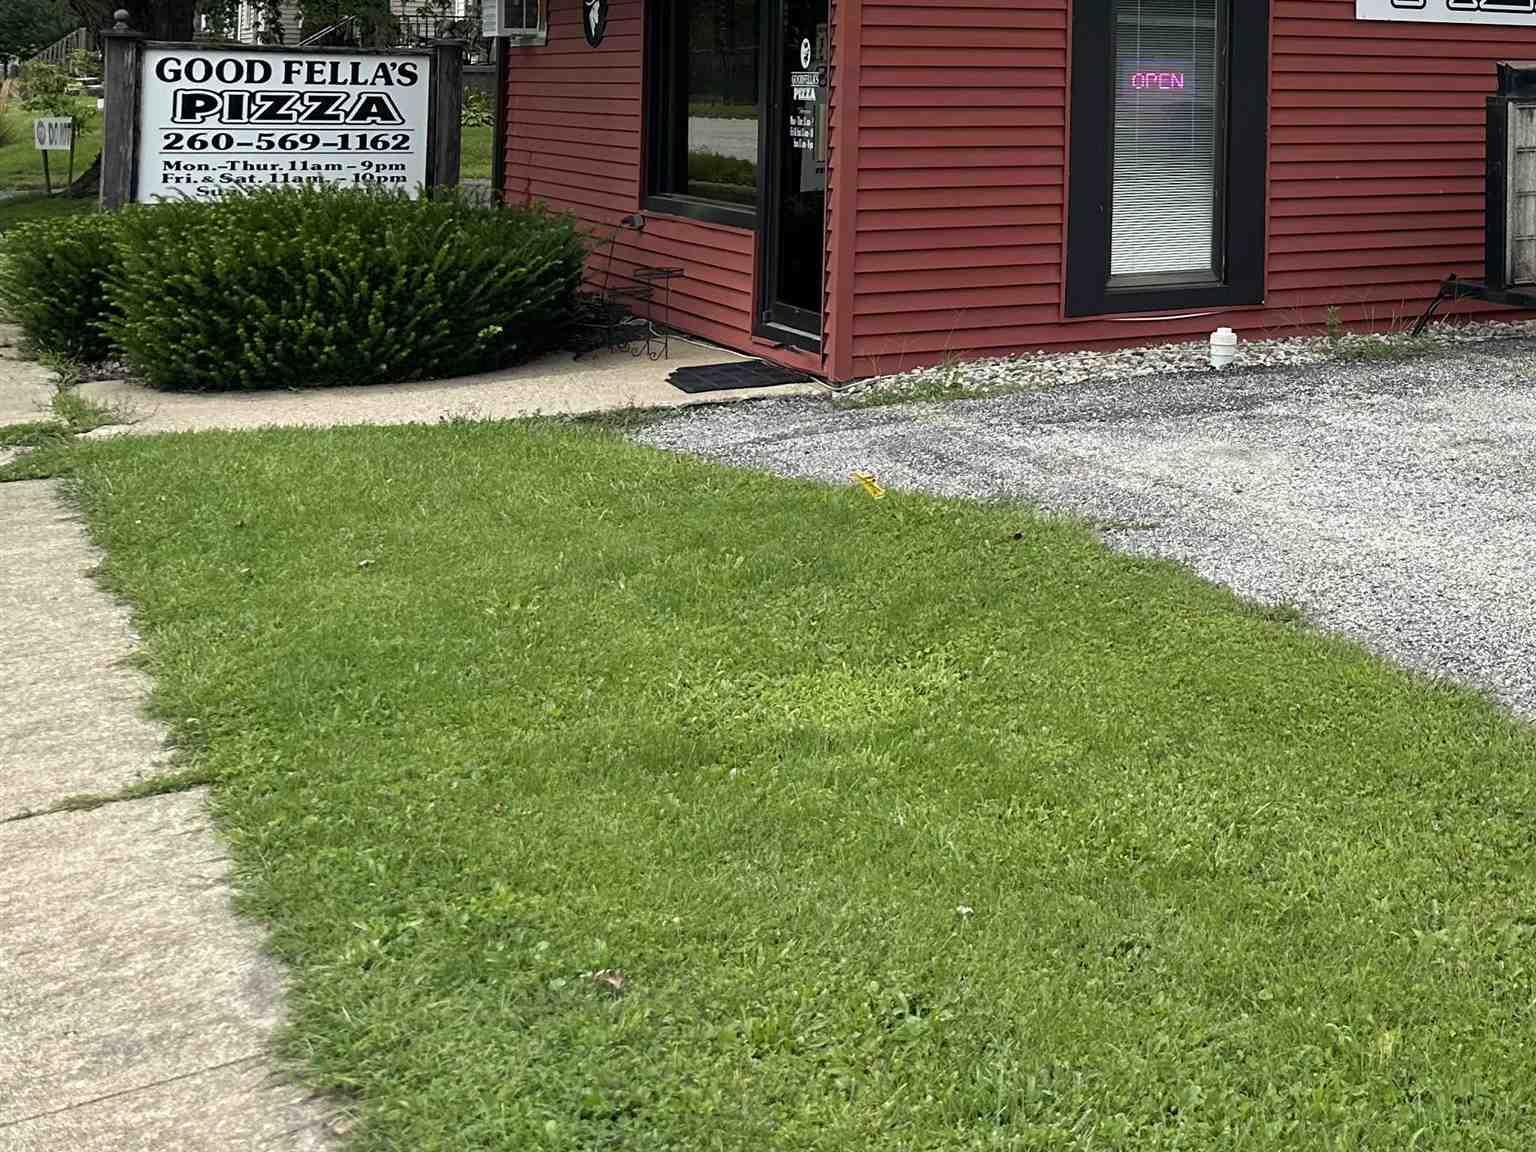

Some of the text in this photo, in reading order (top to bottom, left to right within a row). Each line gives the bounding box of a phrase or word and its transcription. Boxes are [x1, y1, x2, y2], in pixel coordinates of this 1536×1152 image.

[155, 56, 419, 87] GOOD FELLA'S
[1131, 71, 1185, 90] OPEN
[793, 87, 817, 101] PIZZA
[171, 88, 406, 126] PIZZA
[162, 132, 410, 152] 260-569-1162
[161, 173, 198, 184] Fri.
